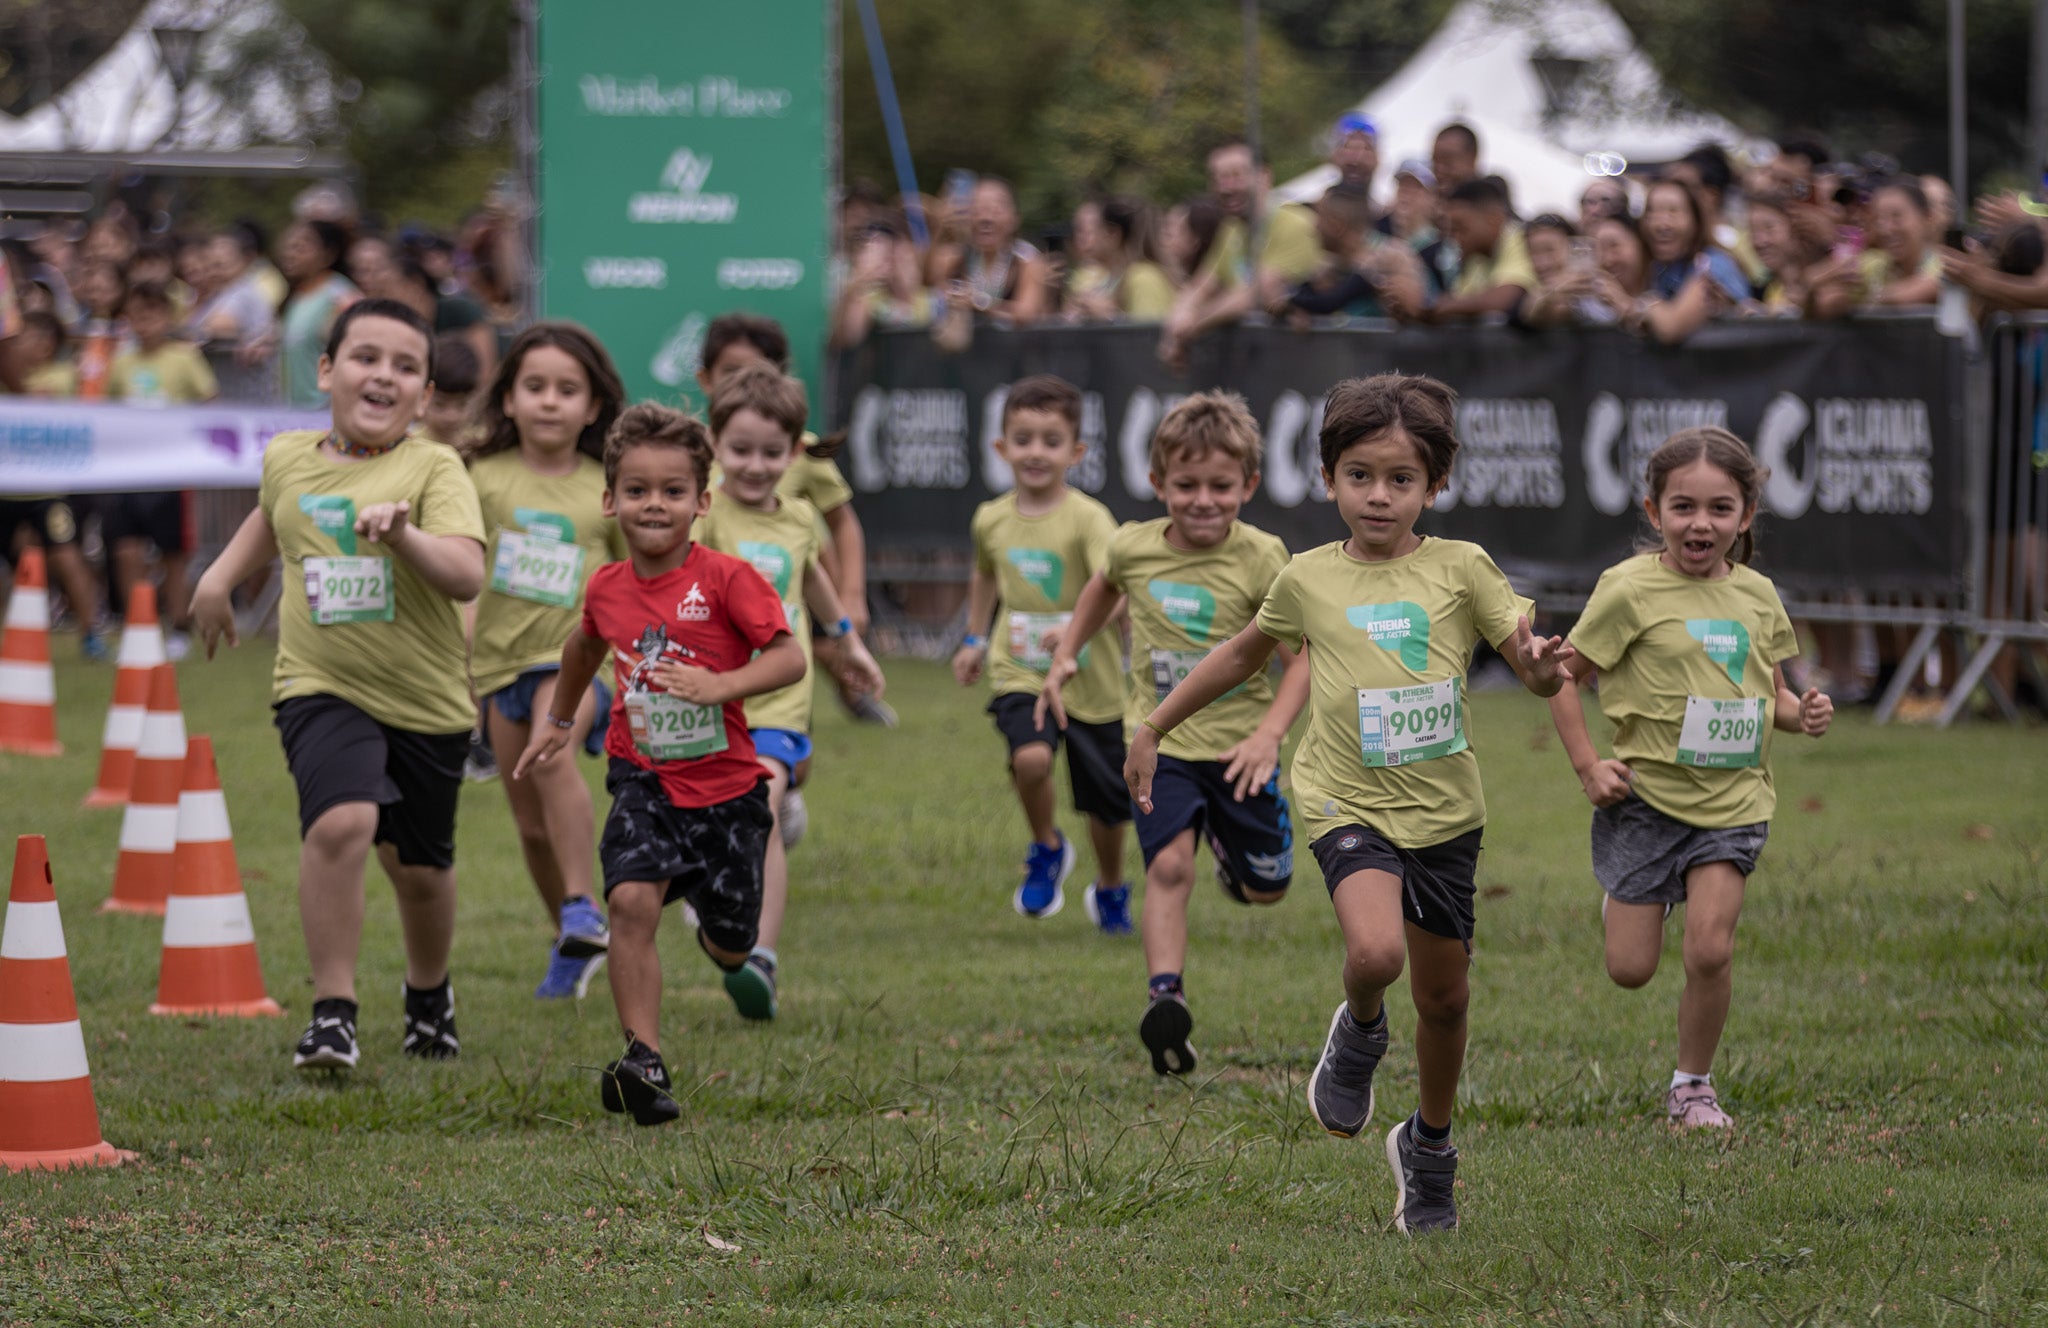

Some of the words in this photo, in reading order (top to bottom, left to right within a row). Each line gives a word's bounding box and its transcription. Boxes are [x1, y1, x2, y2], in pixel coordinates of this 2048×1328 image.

[1815, 397, 1933, 455] IGUANA
[1458, 457, 1565, 508] SPORTS
[1815, 460, 1933, 514] SPORTS
[518, 555, 570, 582] 9097
[326, 577, 381, 598] 9072
[1367, 619, 1411, 632] ATHENAS
[1402, 686, 1434, 698] ATHENAS
[651, 706, 710, 733] 9202
[1361, 708, 1381, 716] 100m
[1390, 703, 1452, 736] 9099
[1415, 733, 1437, 743] CAETANO
[1708, 718, 1755, 740] 9309
[1363, 742, 1384, 750] 2018
